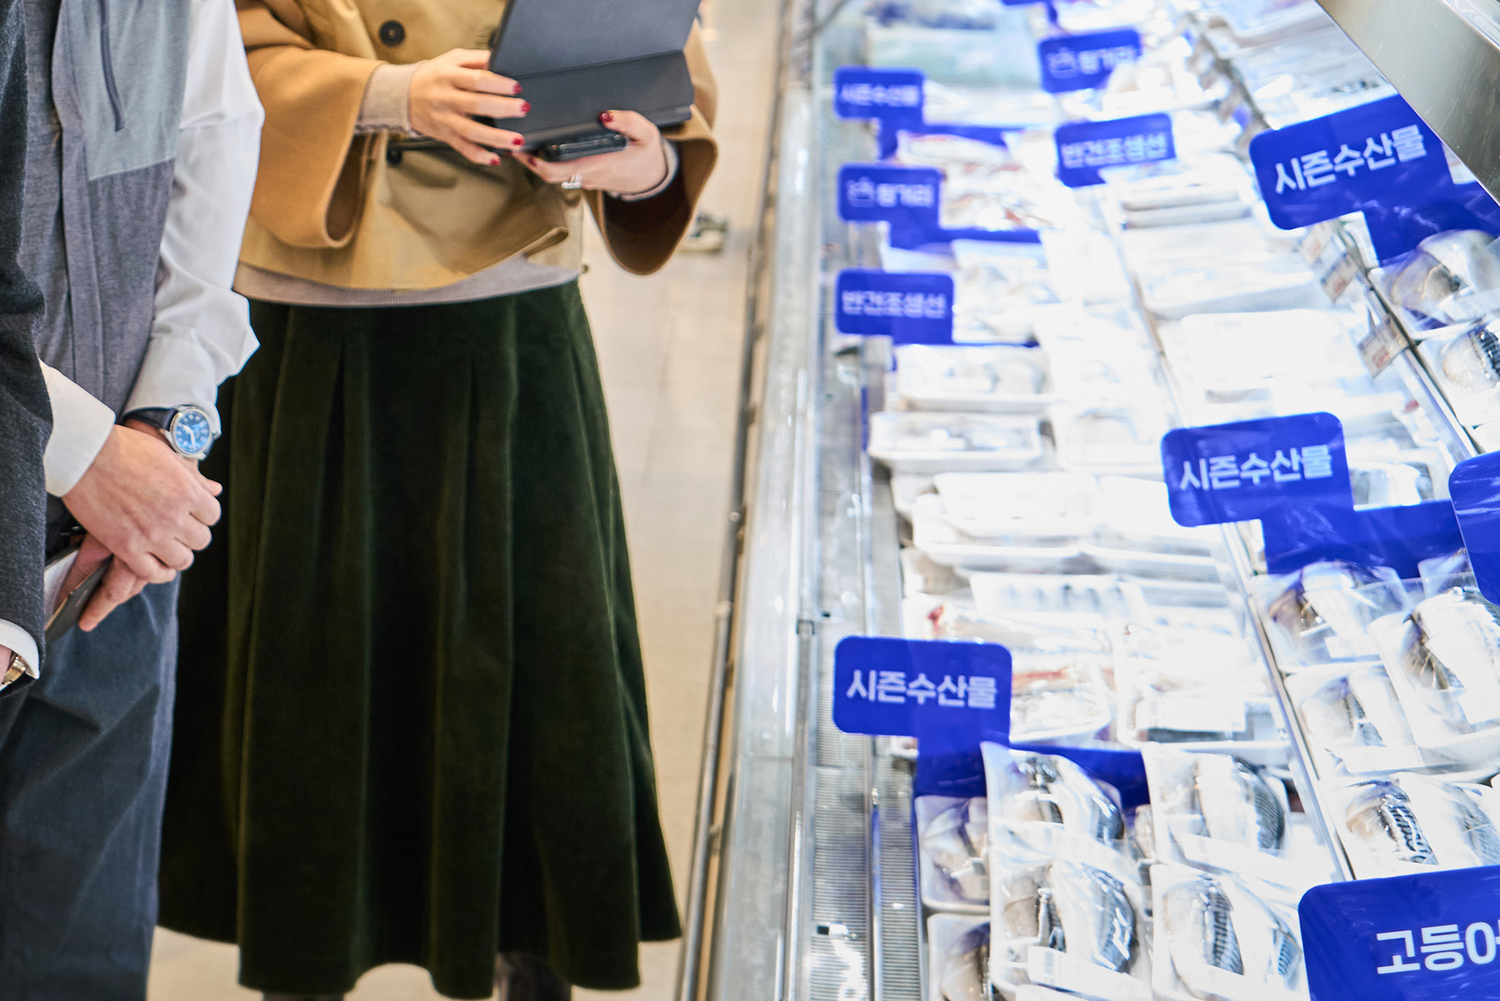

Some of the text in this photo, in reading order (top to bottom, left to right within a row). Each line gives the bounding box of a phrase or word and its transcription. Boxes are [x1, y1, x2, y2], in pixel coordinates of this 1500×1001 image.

[1061, 133, 1168, 169] 반건조생선
[1275, 124, 1427, 194] 시즌수산물
[842, 290, 946, 319] 반건조생선
[1179, 444, 1333, 491] 시즌수산물
[846, 669, 997, 709] 시즌수산물
